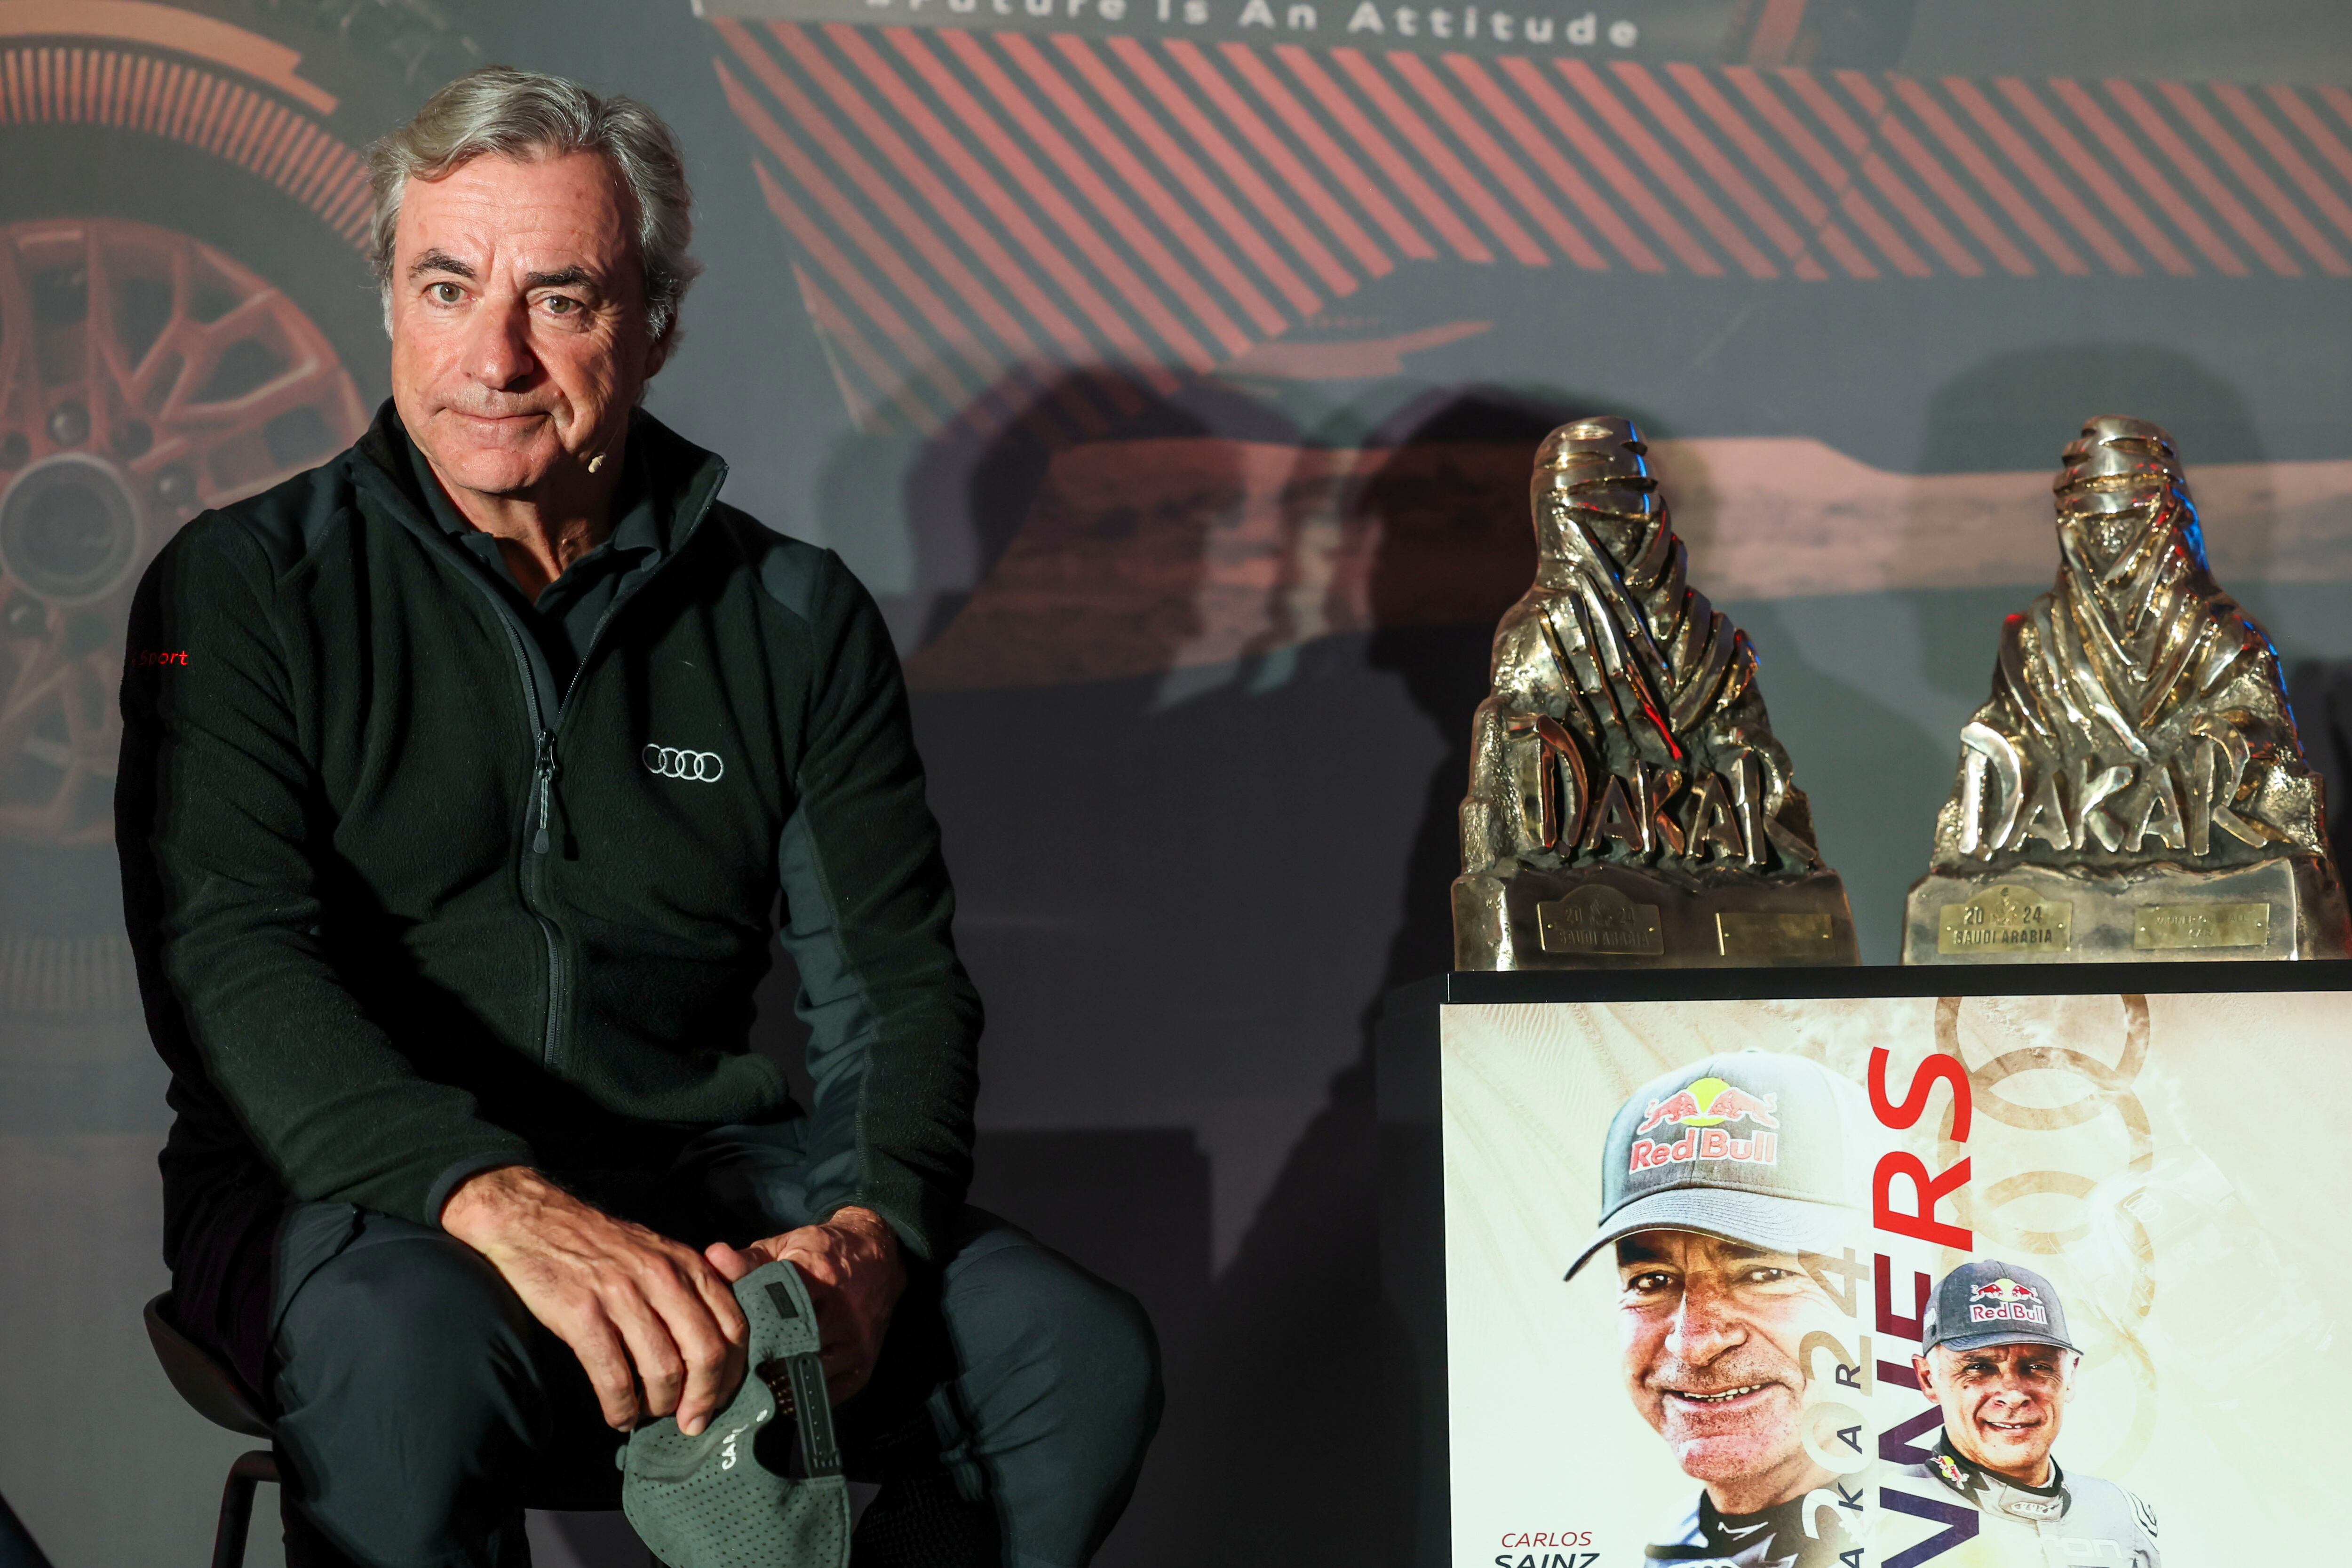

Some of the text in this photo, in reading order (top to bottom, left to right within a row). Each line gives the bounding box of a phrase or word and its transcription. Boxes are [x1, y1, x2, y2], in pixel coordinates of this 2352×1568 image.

[1157, 0, 1210, 24] Is
[1238, 0, 1317, 30] An
[1346, 1, 1638, 48] Attitude
[1534, 714, 1817, 865] DAKAR
[1959, 713, 2268, 860] DAKAR
[1963, 906, 2042, 925] 20 24
[1953, 929, 2052, 945] SAUDI ARABIA
[1631, 1129, 1774, 1170] Red Bull
[1973, 1304, 2045, 1323] Red Bull
[1502, 1532, 1593, 1548] CARLOS
[1495, 1553, 1600, 1568] SAINZ
